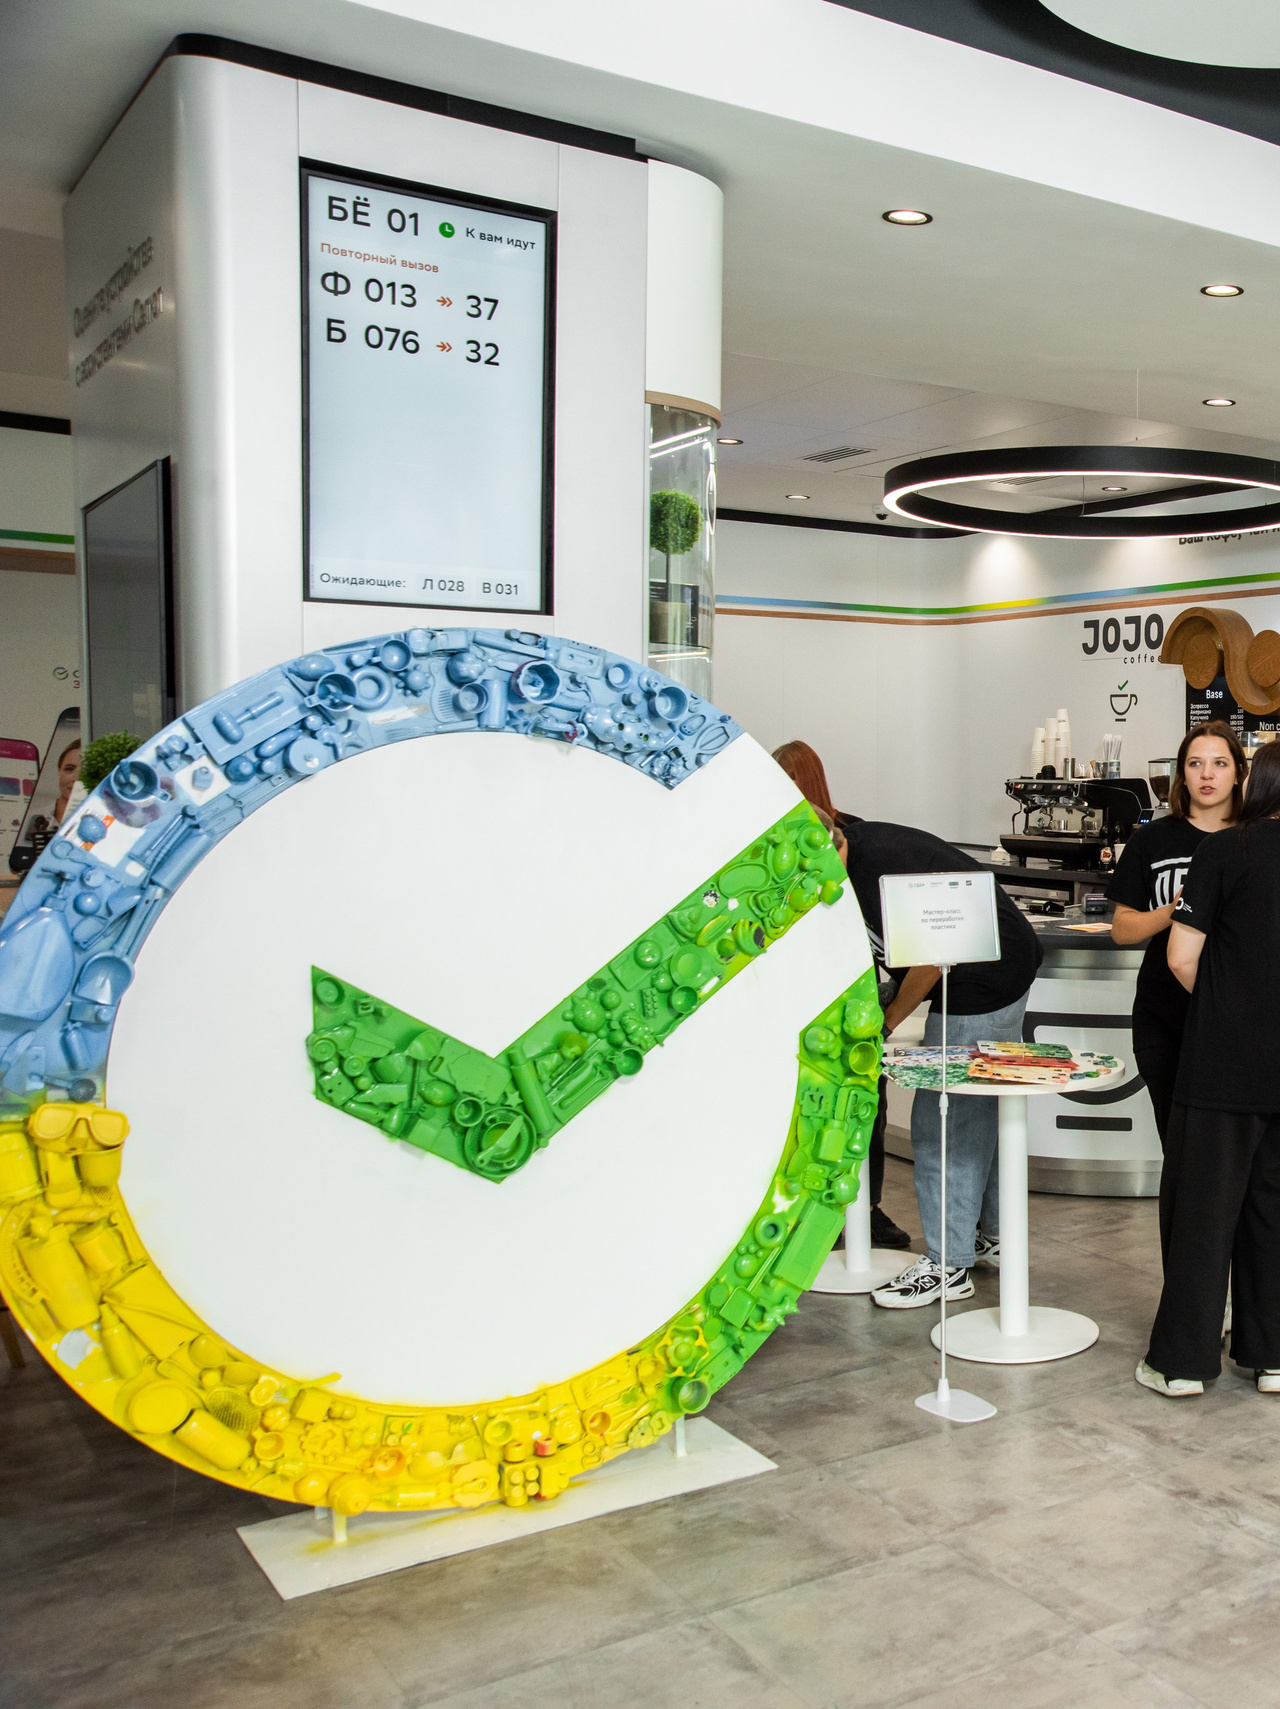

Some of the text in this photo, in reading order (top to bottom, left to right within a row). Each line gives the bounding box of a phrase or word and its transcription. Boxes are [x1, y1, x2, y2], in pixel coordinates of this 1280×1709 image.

[328, 195, 419, 236] БЁ 01
[466, 227, 535, 250] К вам идут
[320, 243, 439, 273] Повторный вызов
[320, 271, 499, 320] Ф 013 37
[326, 317, 500, 366] Б 076 32
[319, 572, 519, 596] Ожидающие: Л 028 В 031
[1082, 613, 1164, 655] JOJO
[1123, 654, 1162, 664] coffee
[1206, 689, 1223, 699] Base
[1260, 721, 1274, 731] Non
